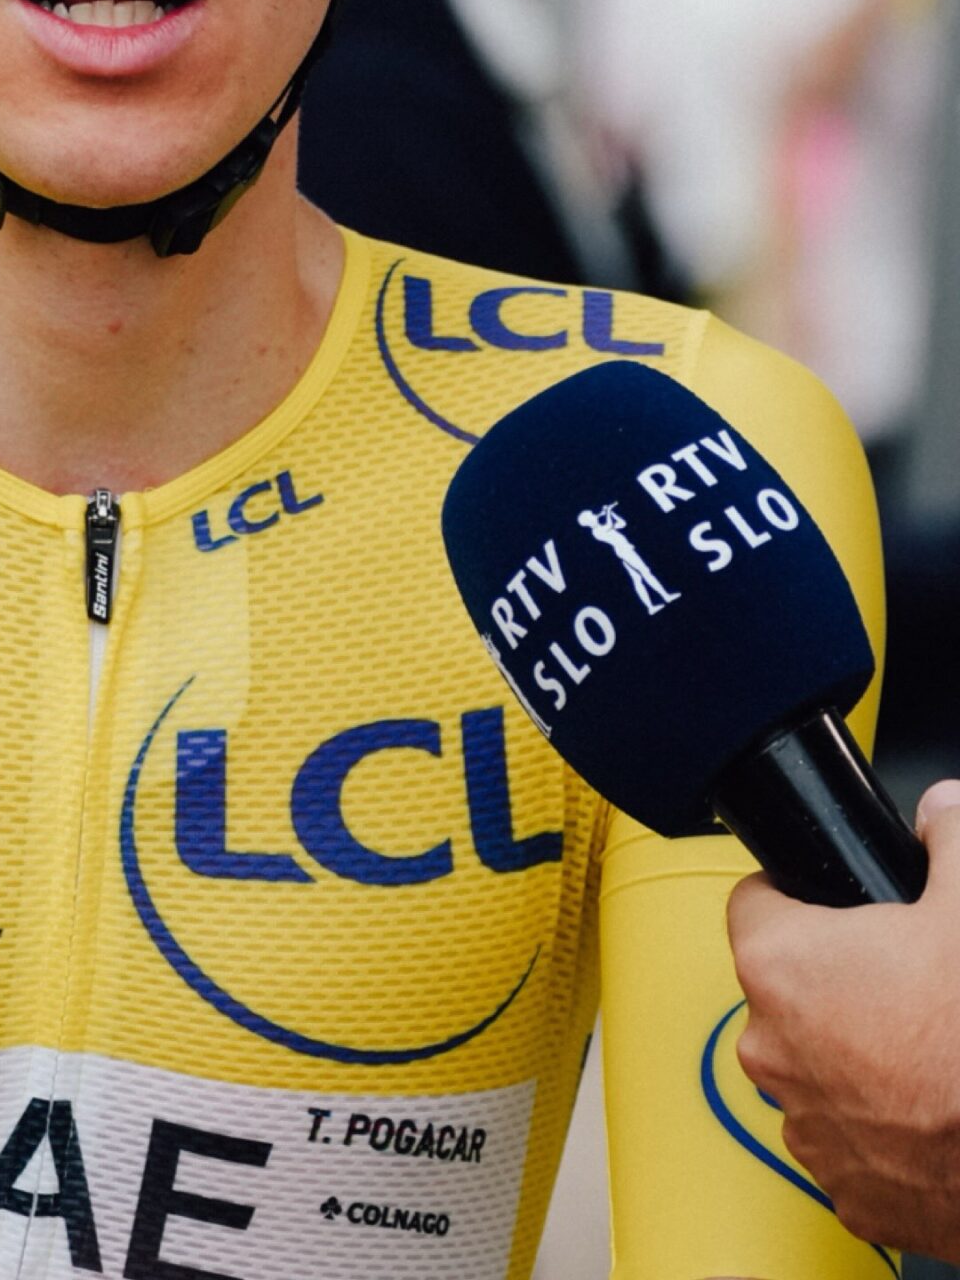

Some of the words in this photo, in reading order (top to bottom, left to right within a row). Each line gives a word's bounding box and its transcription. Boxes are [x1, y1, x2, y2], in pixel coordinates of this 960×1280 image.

[404, 274, 665, 356] LCL
[191, 471, 324, 553] LCL
[637, 429, 748, 513] RTV
[689, 488, 800, 572] SLO
[93, 552, 109, 619] Santini
[491, 539, 567, 651] RTV
[533, 605, 617, 711] SLO
[174, 706, 564, 887] LCL
[307, 1107, 331, 1144] T.
[343, 1113, 487, 1163] POGACAR
[346, 1202, 450, 1237] COLNAGO
